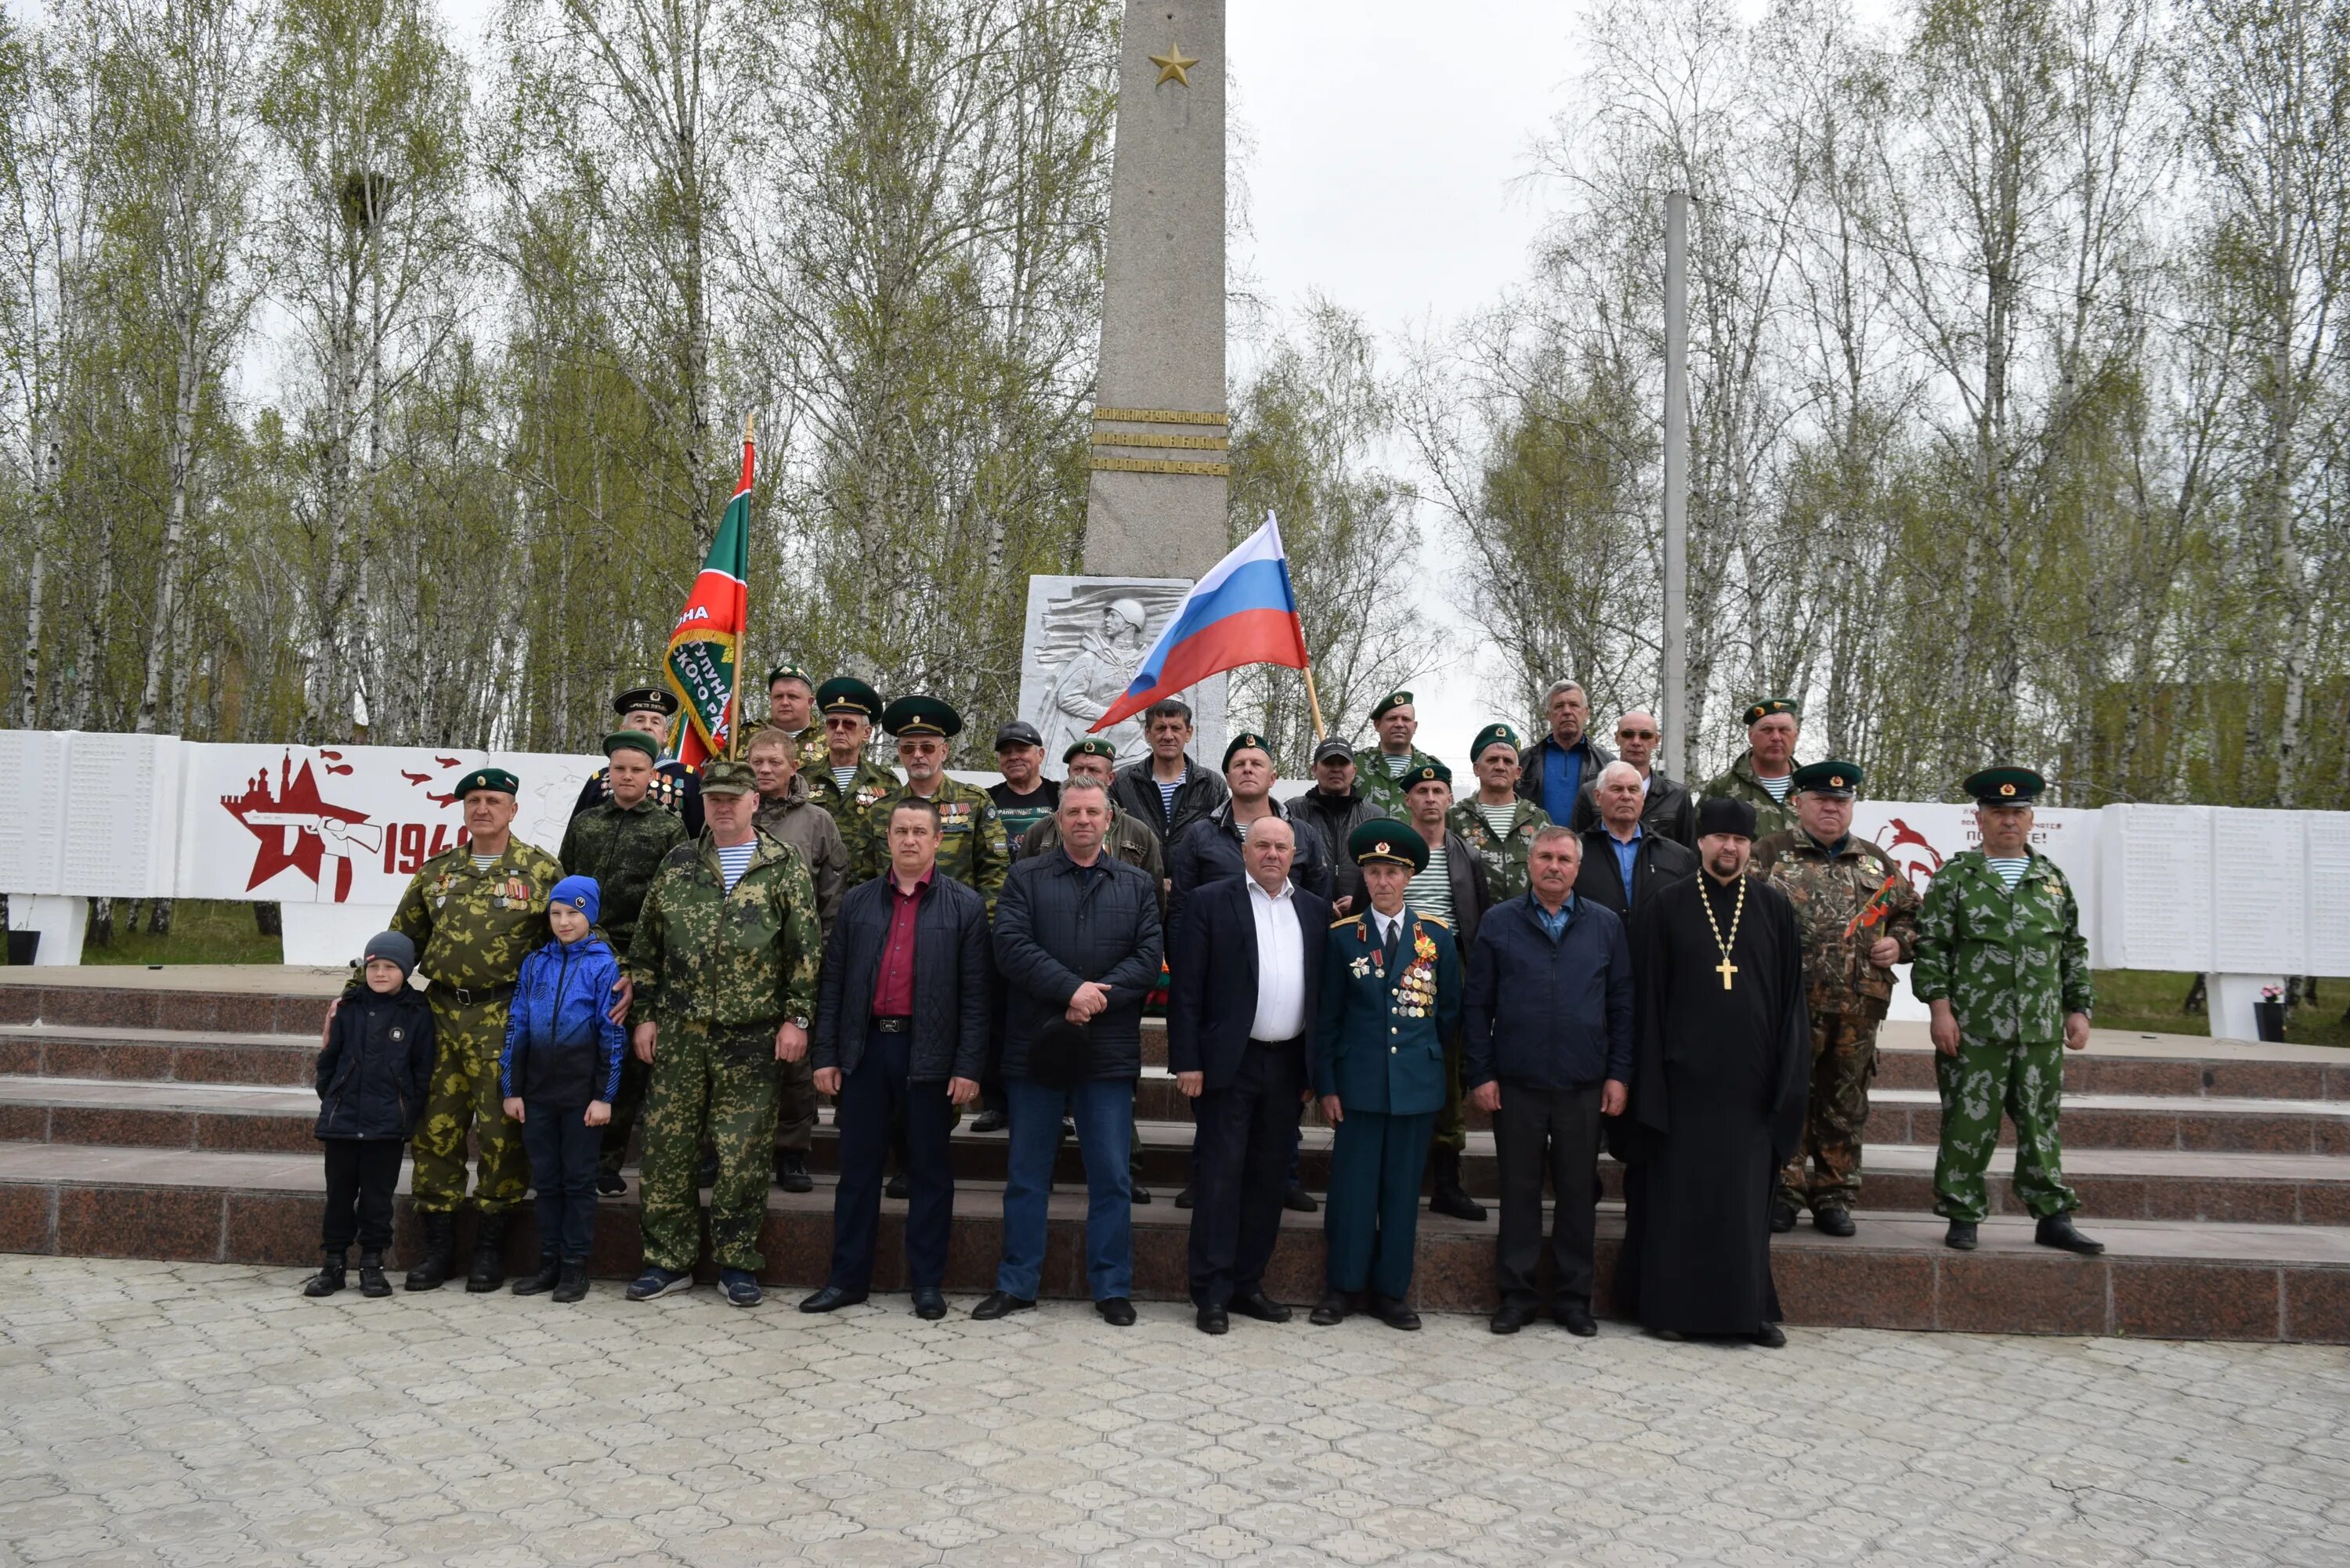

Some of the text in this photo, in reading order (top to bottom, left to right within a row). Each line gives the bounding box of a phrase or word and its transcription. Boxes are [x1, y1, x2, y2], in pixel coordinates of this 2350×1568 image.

[1102, 433, 1217, 449] ПАВШИМ В БОЯХ
[1093, 458, 1108, 469] ЗА
[1115, 459, 1165, 473] РОДИНУ
